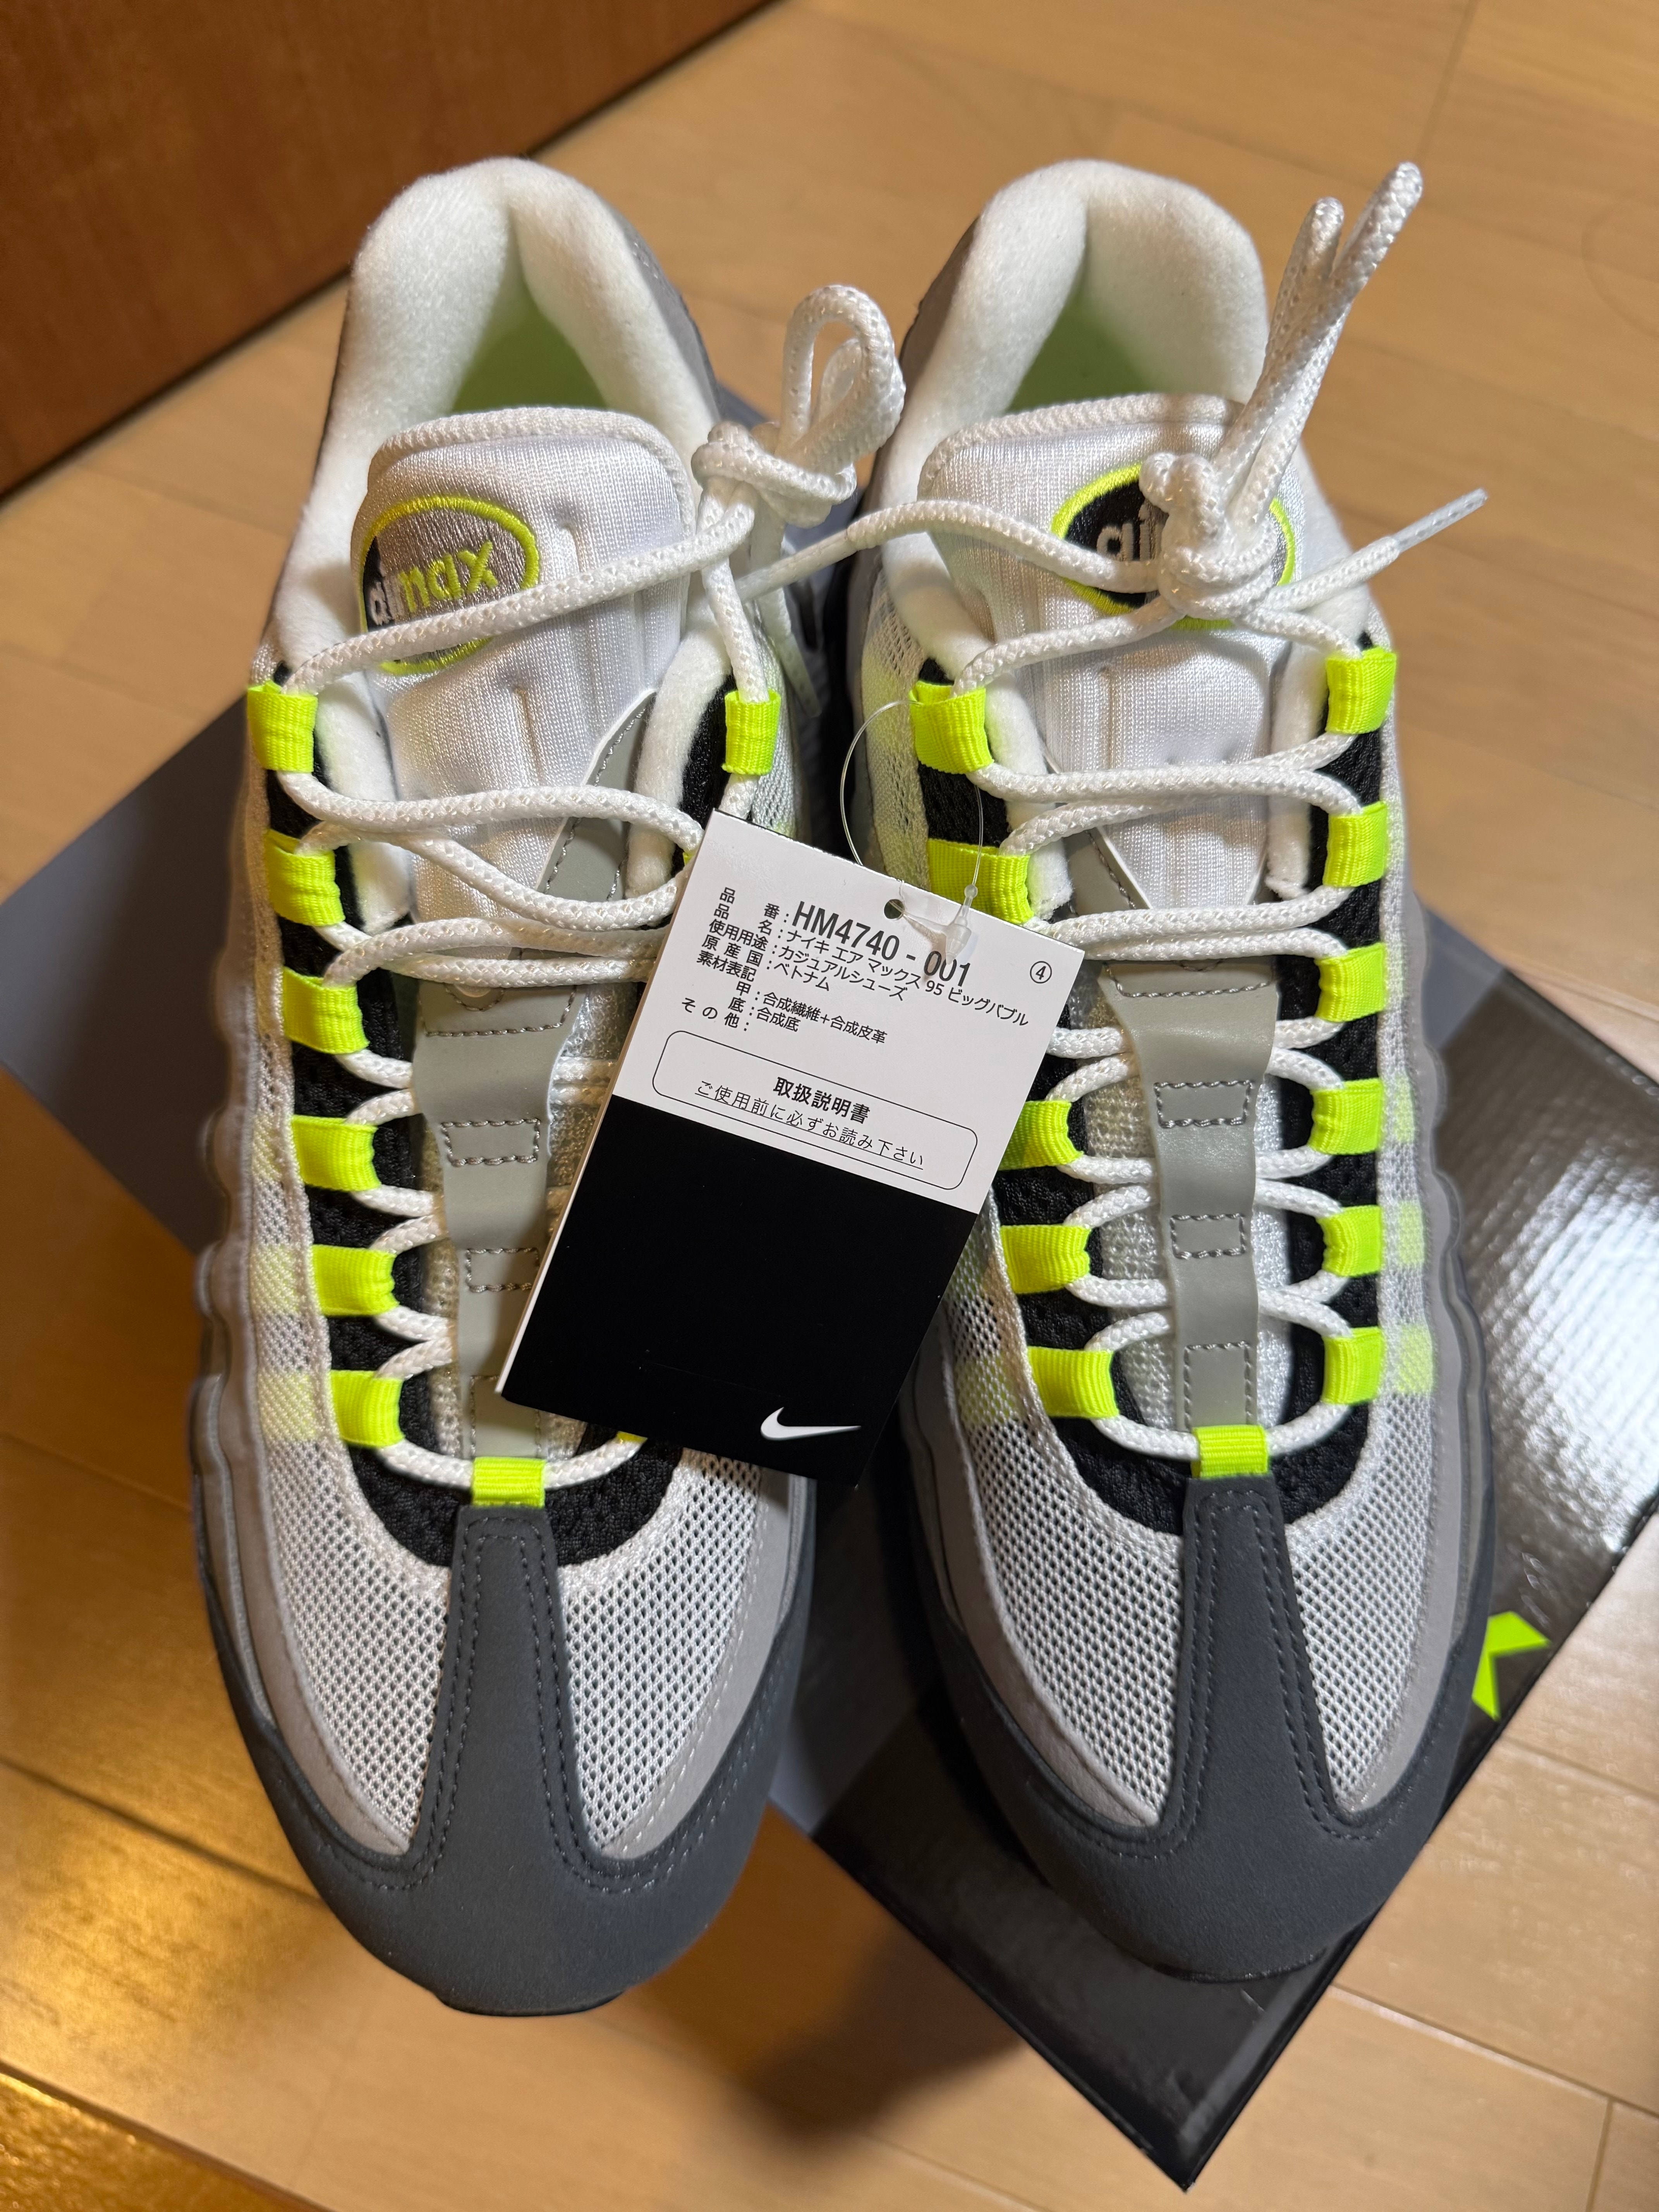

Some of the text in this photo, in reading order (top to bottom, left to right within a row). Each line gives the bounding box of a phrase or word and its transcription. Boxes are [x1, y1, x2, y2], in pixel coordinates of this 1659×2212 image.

[1096, 503, 1162, 562] ai
[792, 901, 899, 960] HM4740
[697, 950, 757, 982] 素材表記
[787, 930, 829, 954] ナイキ
[832, 947, 863, 963] エア
[869, 958, 921, 989] マックス
[926, 981, 944, 995] 95
[948, 988, 1028, 1025] ビッグバブル
[697, 1081, 924, 1165] ご使用前に必ずお読み下さい
[773, 1077, 871, 1124] 取扱説明書
